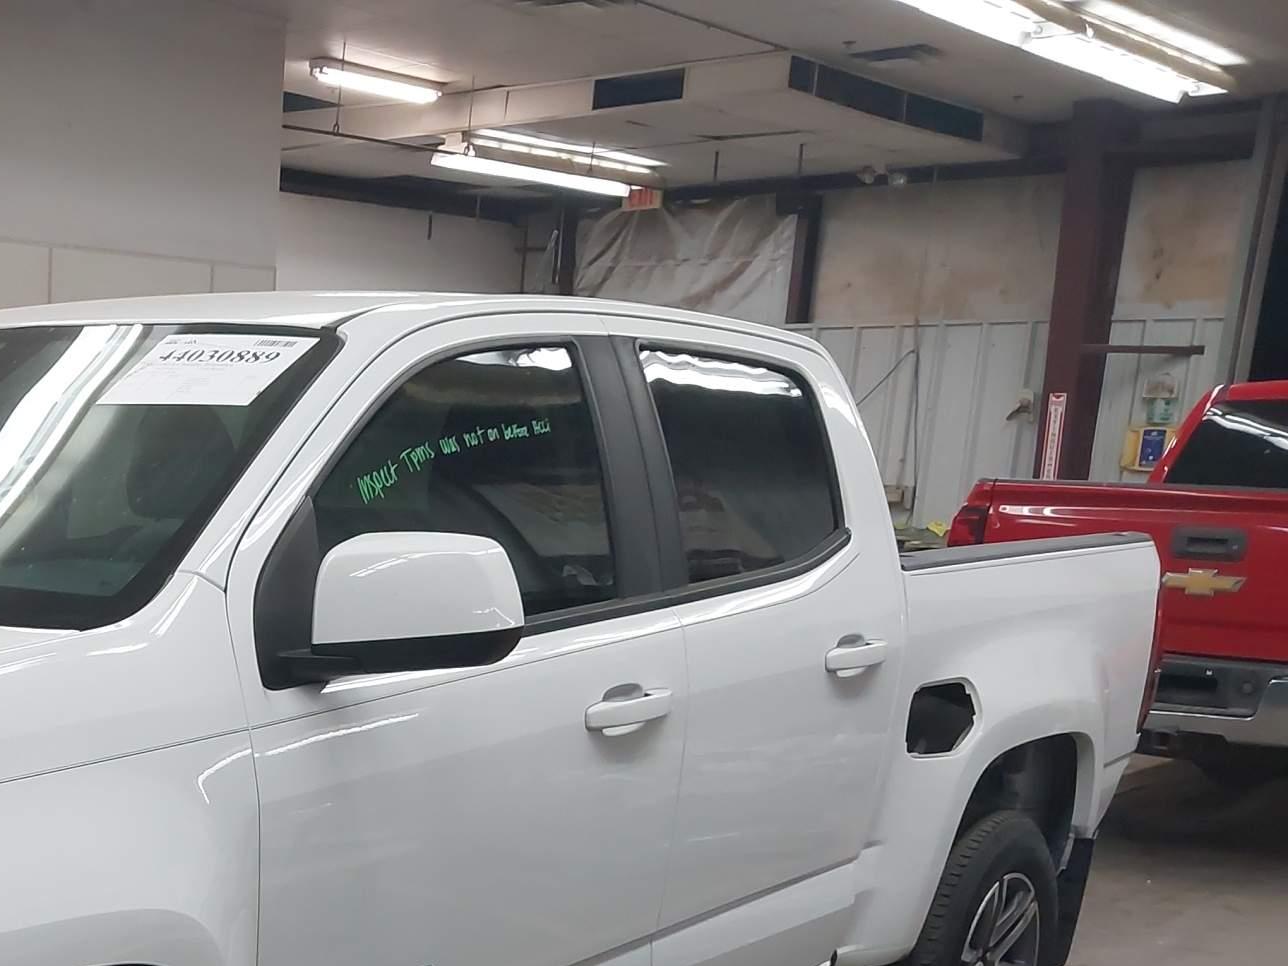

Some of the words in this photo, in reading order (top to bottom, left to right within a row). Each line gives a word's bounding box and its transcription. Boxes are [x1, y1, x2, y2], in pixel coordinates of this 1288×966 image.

[159, 349, 281, 364] 44030889
[463, 426, 485, 448] not
[487, 428, 500, 442] on
